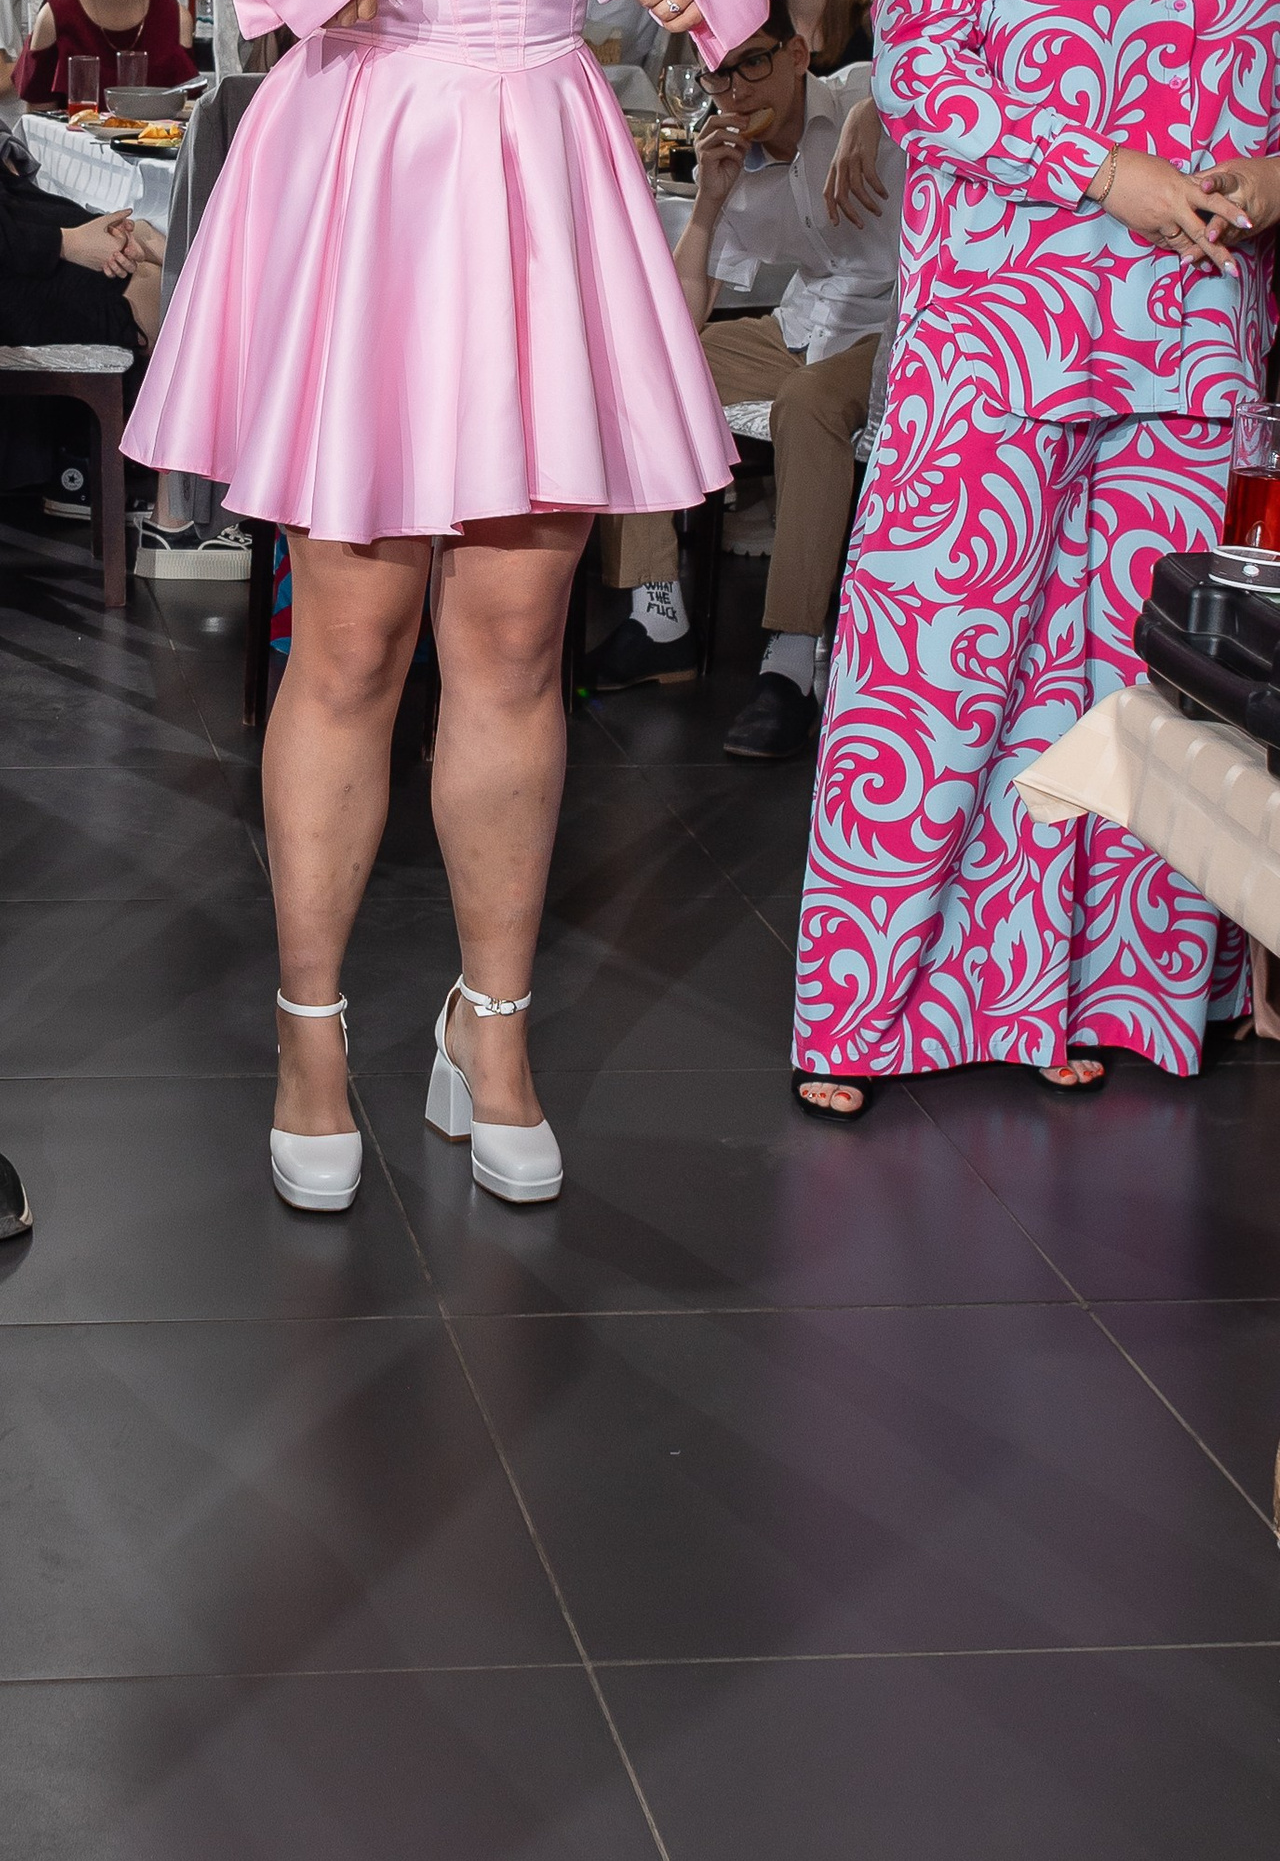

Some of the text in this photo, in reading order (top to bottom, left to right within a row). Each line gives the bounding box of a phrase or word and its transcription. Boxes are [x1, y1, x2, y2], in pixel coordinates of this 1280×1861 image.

[643, 581, 673, 593] WHAT
[646, 591, 671, 604] THE
[646, 602, 678, 623] FUCK
